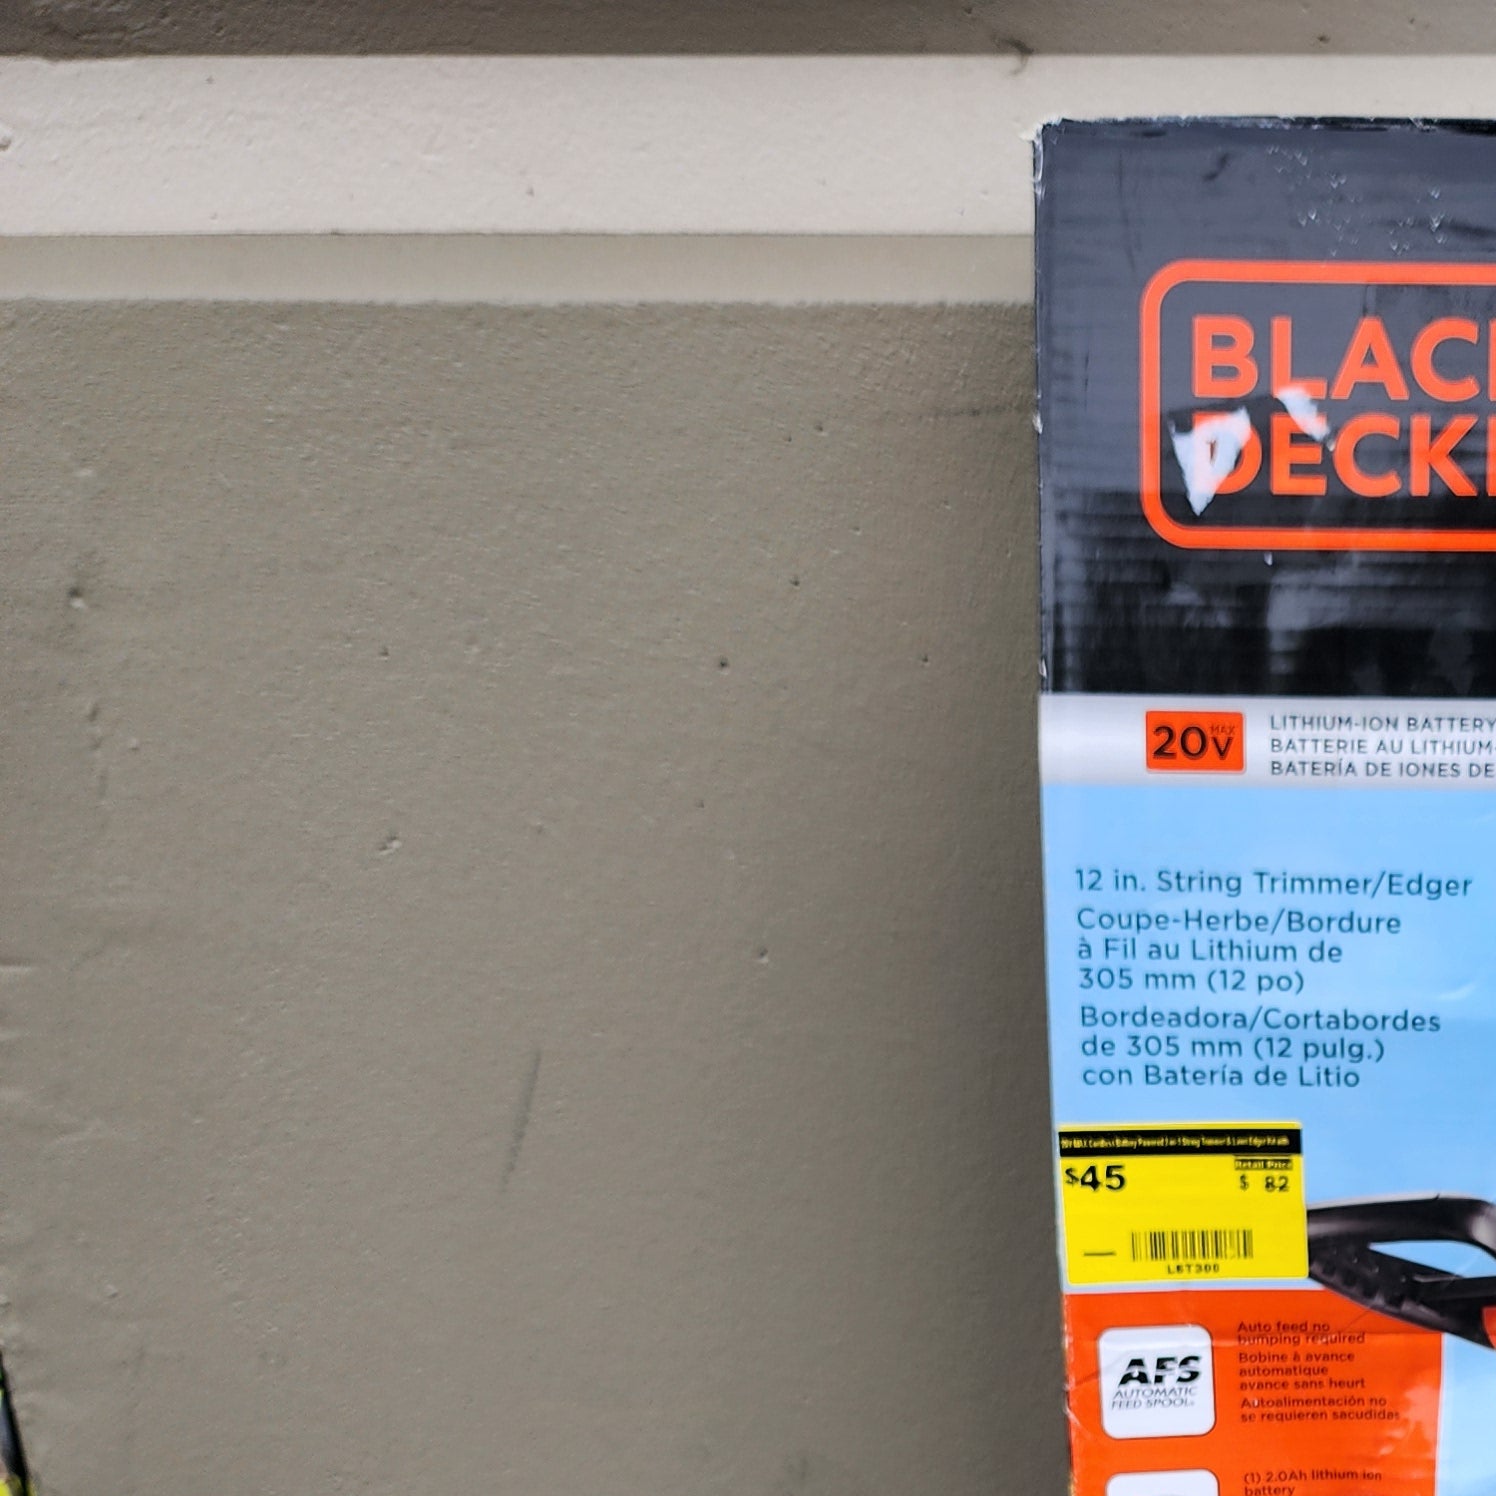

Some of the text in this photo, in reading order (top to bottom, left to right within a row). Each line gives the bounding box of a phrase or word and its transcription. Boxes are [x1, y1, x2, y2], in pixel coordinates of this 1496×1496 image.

[1270, 715, 1399, 732] LITHIUM-ION
[1152, 726, 1234, 760] 20V
[1271, 738, 1369, 755] BATTERIE
[1376, 738, 1404, 755] AU
[1270, 758, 1357, 777] BATERÍA
[1365, 762, 1391, 777] DE
[1399, 762, 1461, 778] IONES
[1469, 762, 1495, 778] DE
[1075, 869, 1473, 900] 12 in. String Trimmer/Edger
[1077, 907, 1402, 935] Coupe-Herbe/Bordure
[1077, 936, 1343, 963] à Fil au Lithium de
[1078, 967, 1305, 995] 305 mm (12 po)
[1080, 1005, 1441, 1033] Bordeadora/Cortabordes
[1081, 1035, 1385, 1063] de 305 mm (12 pulg.)
[1082, 1064, 1360, 1088] con Batería de Litio
[1065, 1164, 1125, 1192] $45
[1265, 1175, 1289, 1192] 82
[1237, 1321, 1330, 1333] Auto feed no
[1237, 1332, 1366, 1346] bumping required
[1238, 1352, 1288, 1363] Bobine
[1305, 1353, 1355, 1363] avance
[1118, 1355, 1201, 1386] AFS
[1239, 1365, 1328, 1377] automatique
[1113, 1387, 1197, 1399] AUTOMATIC
[1240, 1378, 1366, 1391] avance sans heurt
[1112, 1399, 1141, 1410] FEED
[1241, 1395, 1387, 1409] Autoalimentación no
[1241, 1408, 1399, 1424] se requieren sacudidas
[1244, 1471, 1261, 1485] (1)
[1266, 1469, 1307, 1483] 2.0Ah
